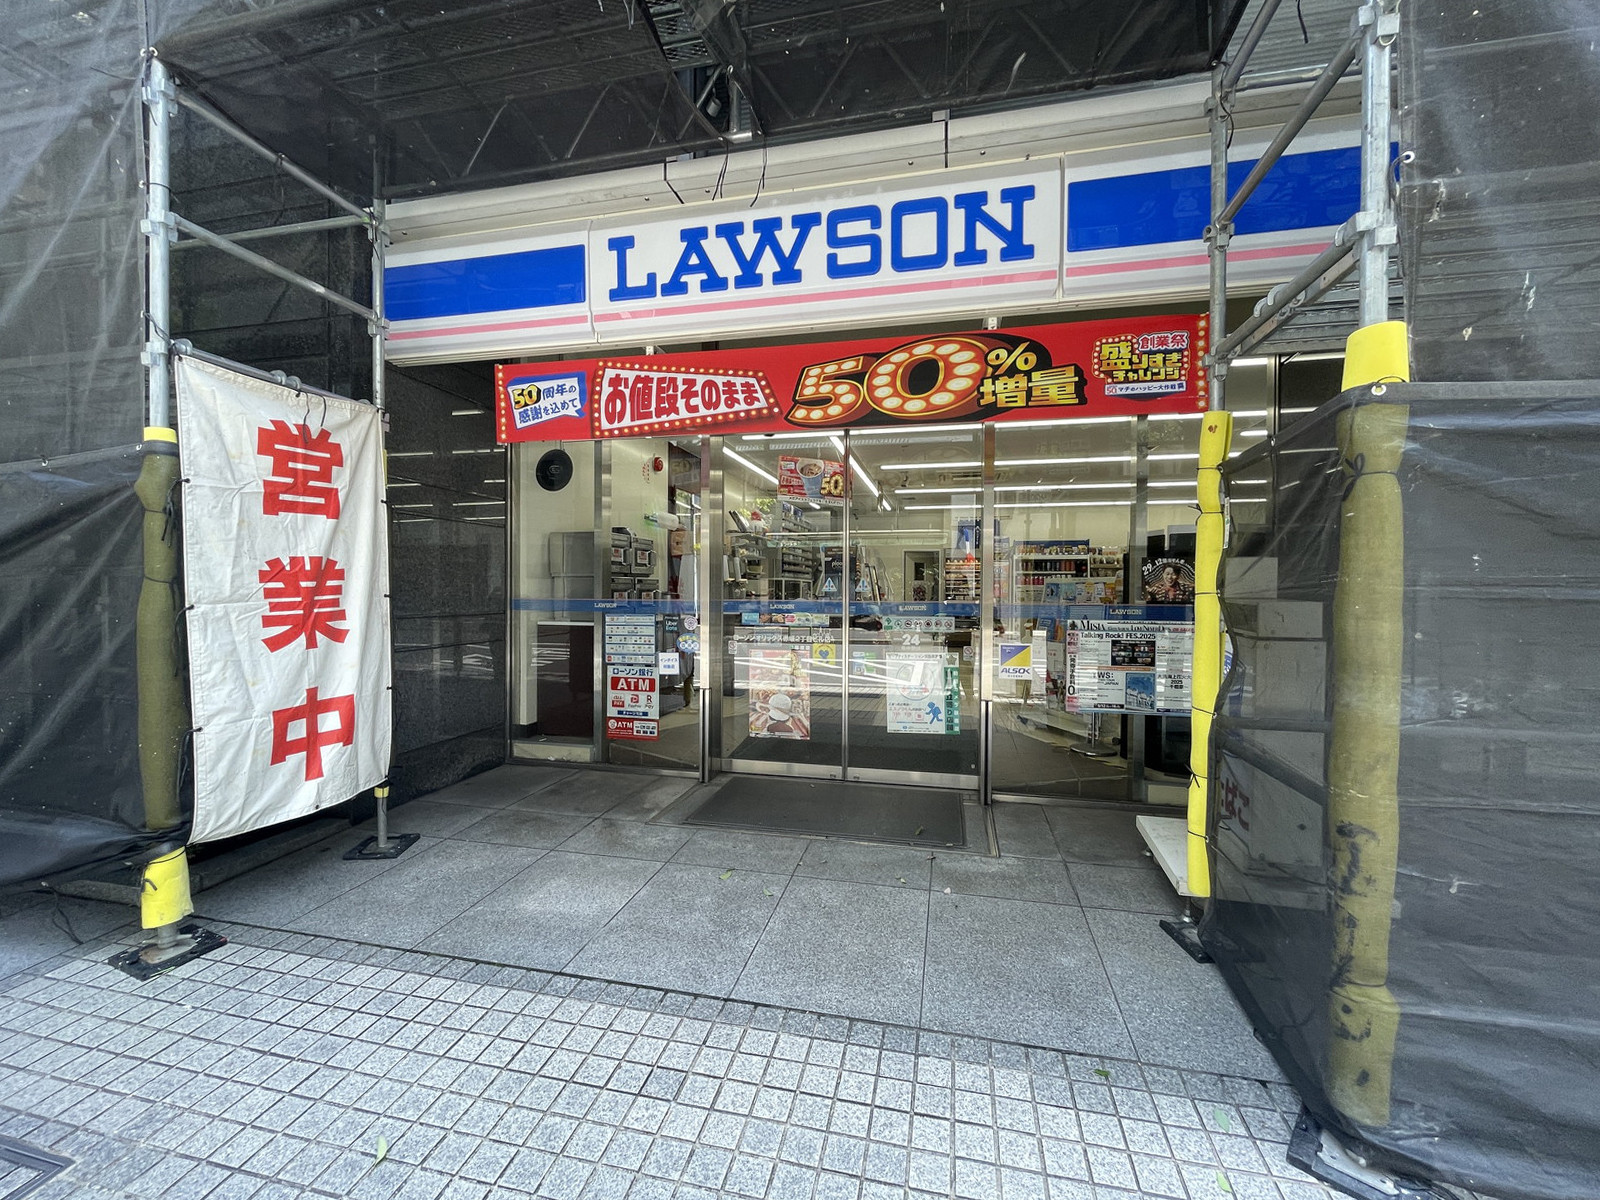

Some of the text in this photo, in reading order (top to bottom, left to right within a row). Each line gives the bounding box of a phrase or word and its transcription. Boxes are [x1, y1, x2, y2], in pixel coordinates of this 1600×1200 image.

[607, 184, 1036, 302] LAWSON
[1139, 333, 1187, 350] 創業祭
[1099, 341, 1183, 371] 盛りすぎ
[785, 336, 1038, 426] 50%
[1112, 367, 1180, 382] チャレンジ
[978, 364, 1080, 408] 増量
[511, 384, 577, 410] 50周年の
[603, 373, 762, 425] お値段そのまま
[518, 397, 579, 424] 感謝を込めて
[257, 419, 356, 782] 営業中
[901, 633, 921, 646] 24
[1080, 632, 1104, 640] Talking
[1125, 632, 1156, 640] FES.2025
[612, 667, 653, 677] ローソン銀行
[1000, 666, 1031, 675] ALSOK
[616, 677, 650, 691] ATM
[617, 721, 633, 729] ATM
